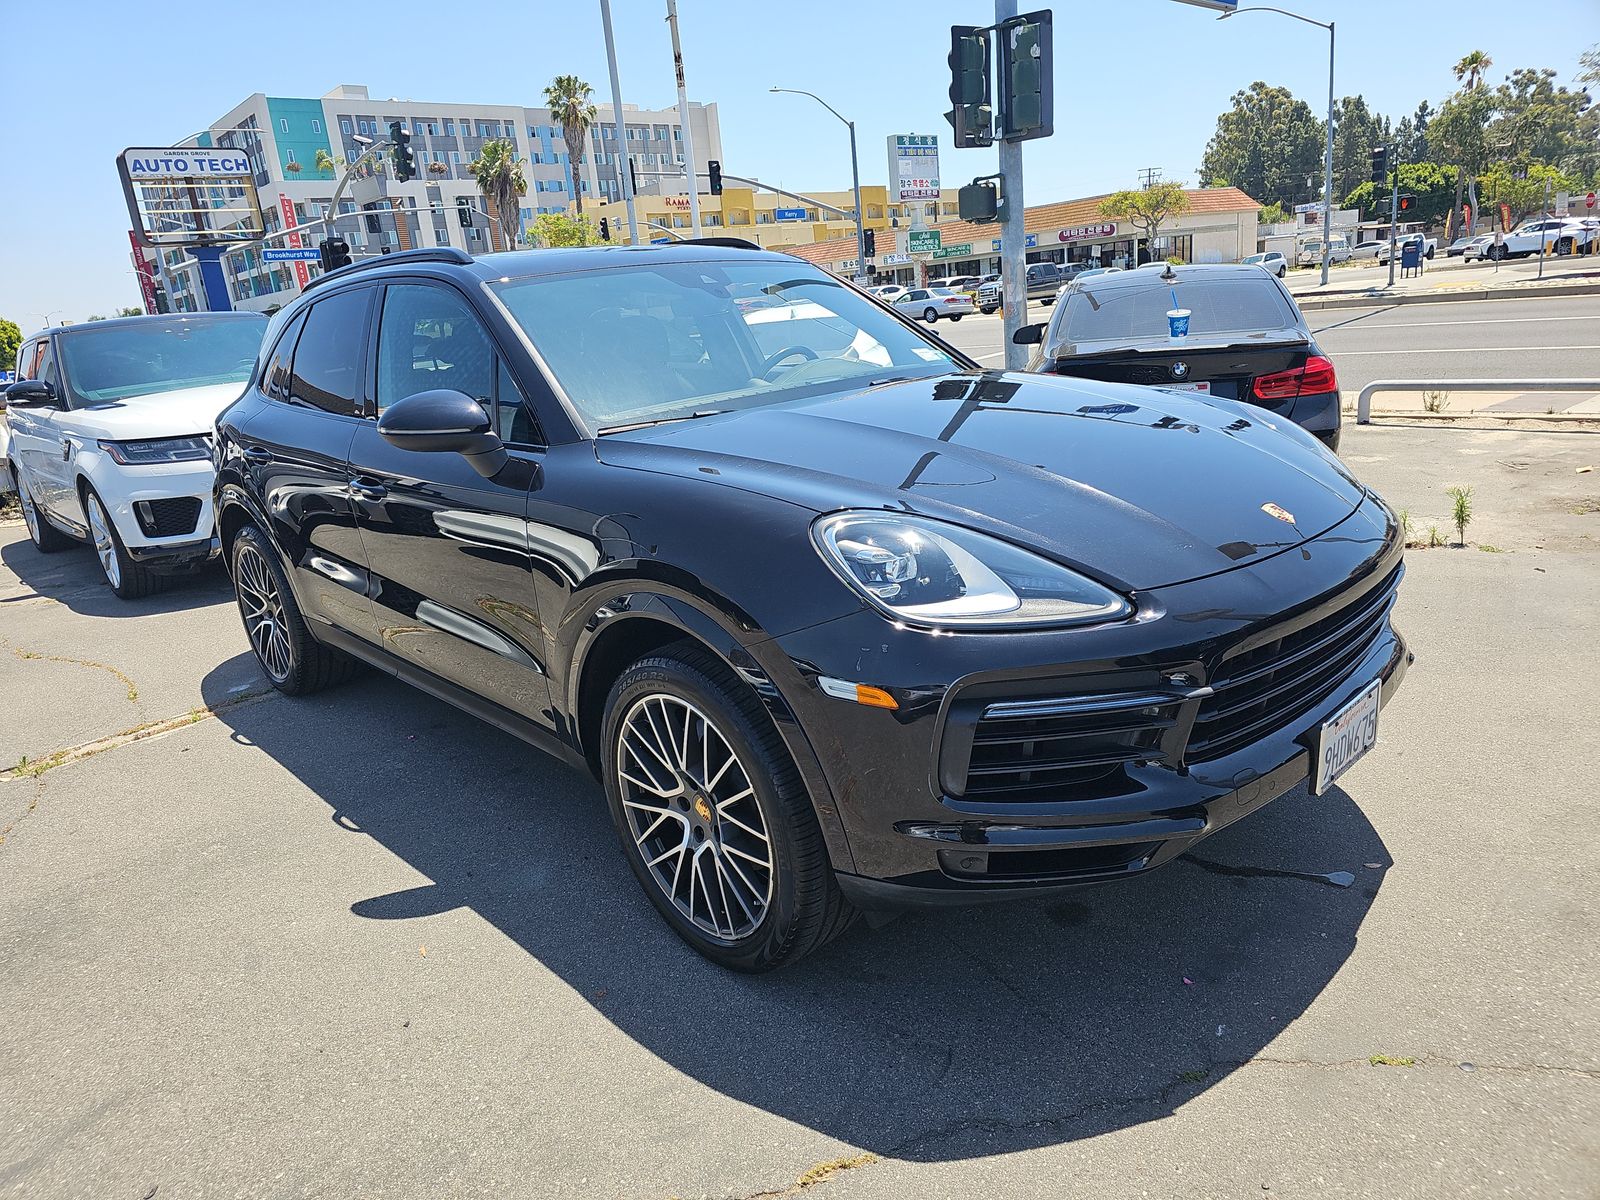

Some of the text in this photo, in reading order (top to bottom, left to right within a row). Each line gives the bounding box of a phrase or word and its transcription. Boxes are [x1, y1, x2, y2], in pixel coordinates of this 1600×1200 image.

[132, 158, 248, 172] AUTO TECH
[284, 201, 297, 240] LEASIG
[267, 251, 317, 259] Brookhurst Way
[1334, 702, 1370, 735] California
[1324, 709, 1376, 781] 9HDW675
